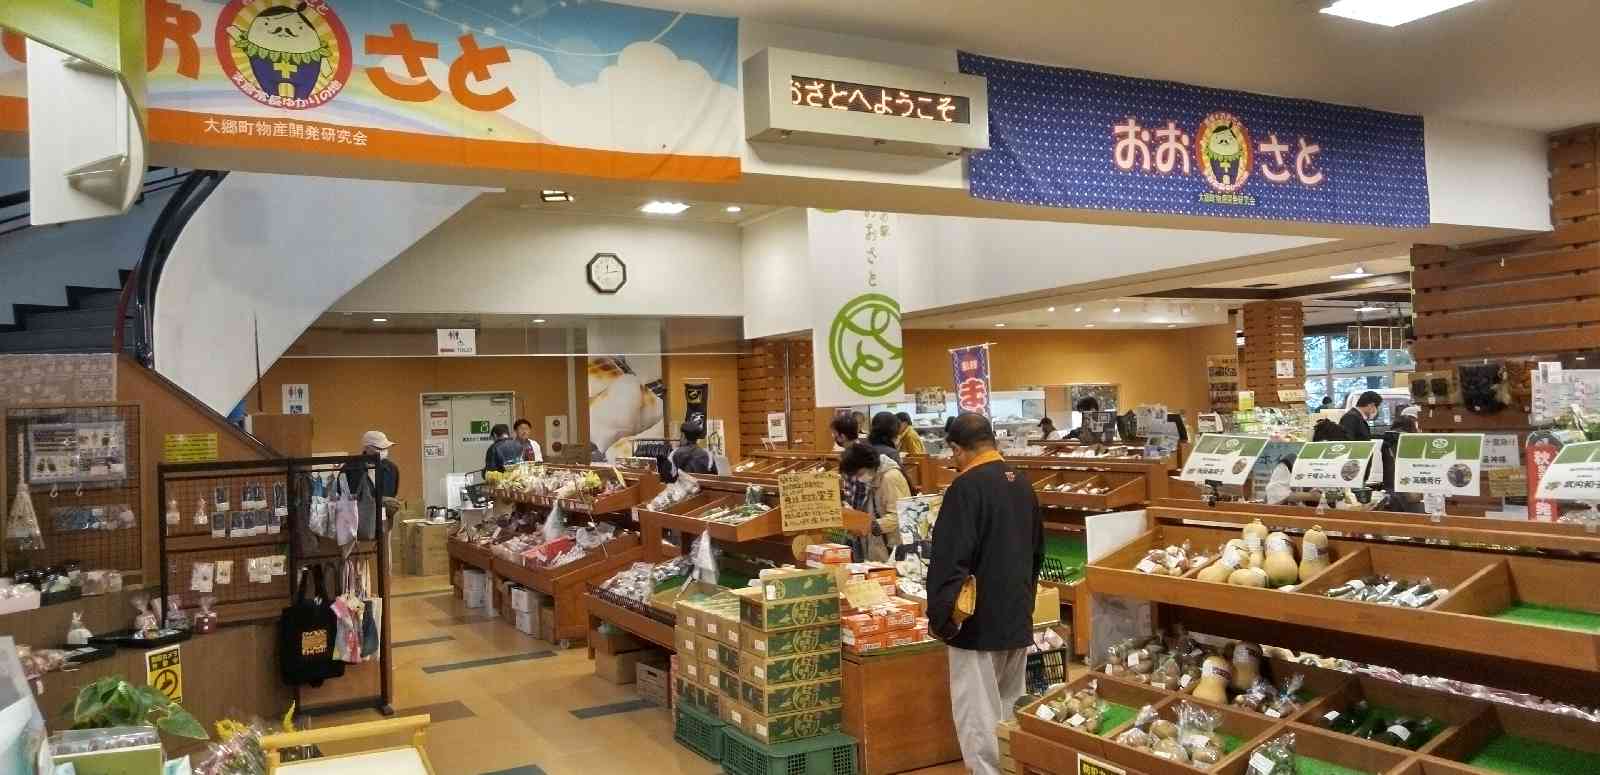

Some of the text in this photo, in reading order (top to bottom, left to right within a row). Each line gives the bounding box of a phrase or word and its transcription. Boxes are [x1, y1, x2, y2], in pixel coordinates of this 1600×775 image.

[364, 23, 516, 112] さと
[204, 118, 368, 146] 大郷町物産開発研究会
[1113, 117, 1323, 184] おお さと
